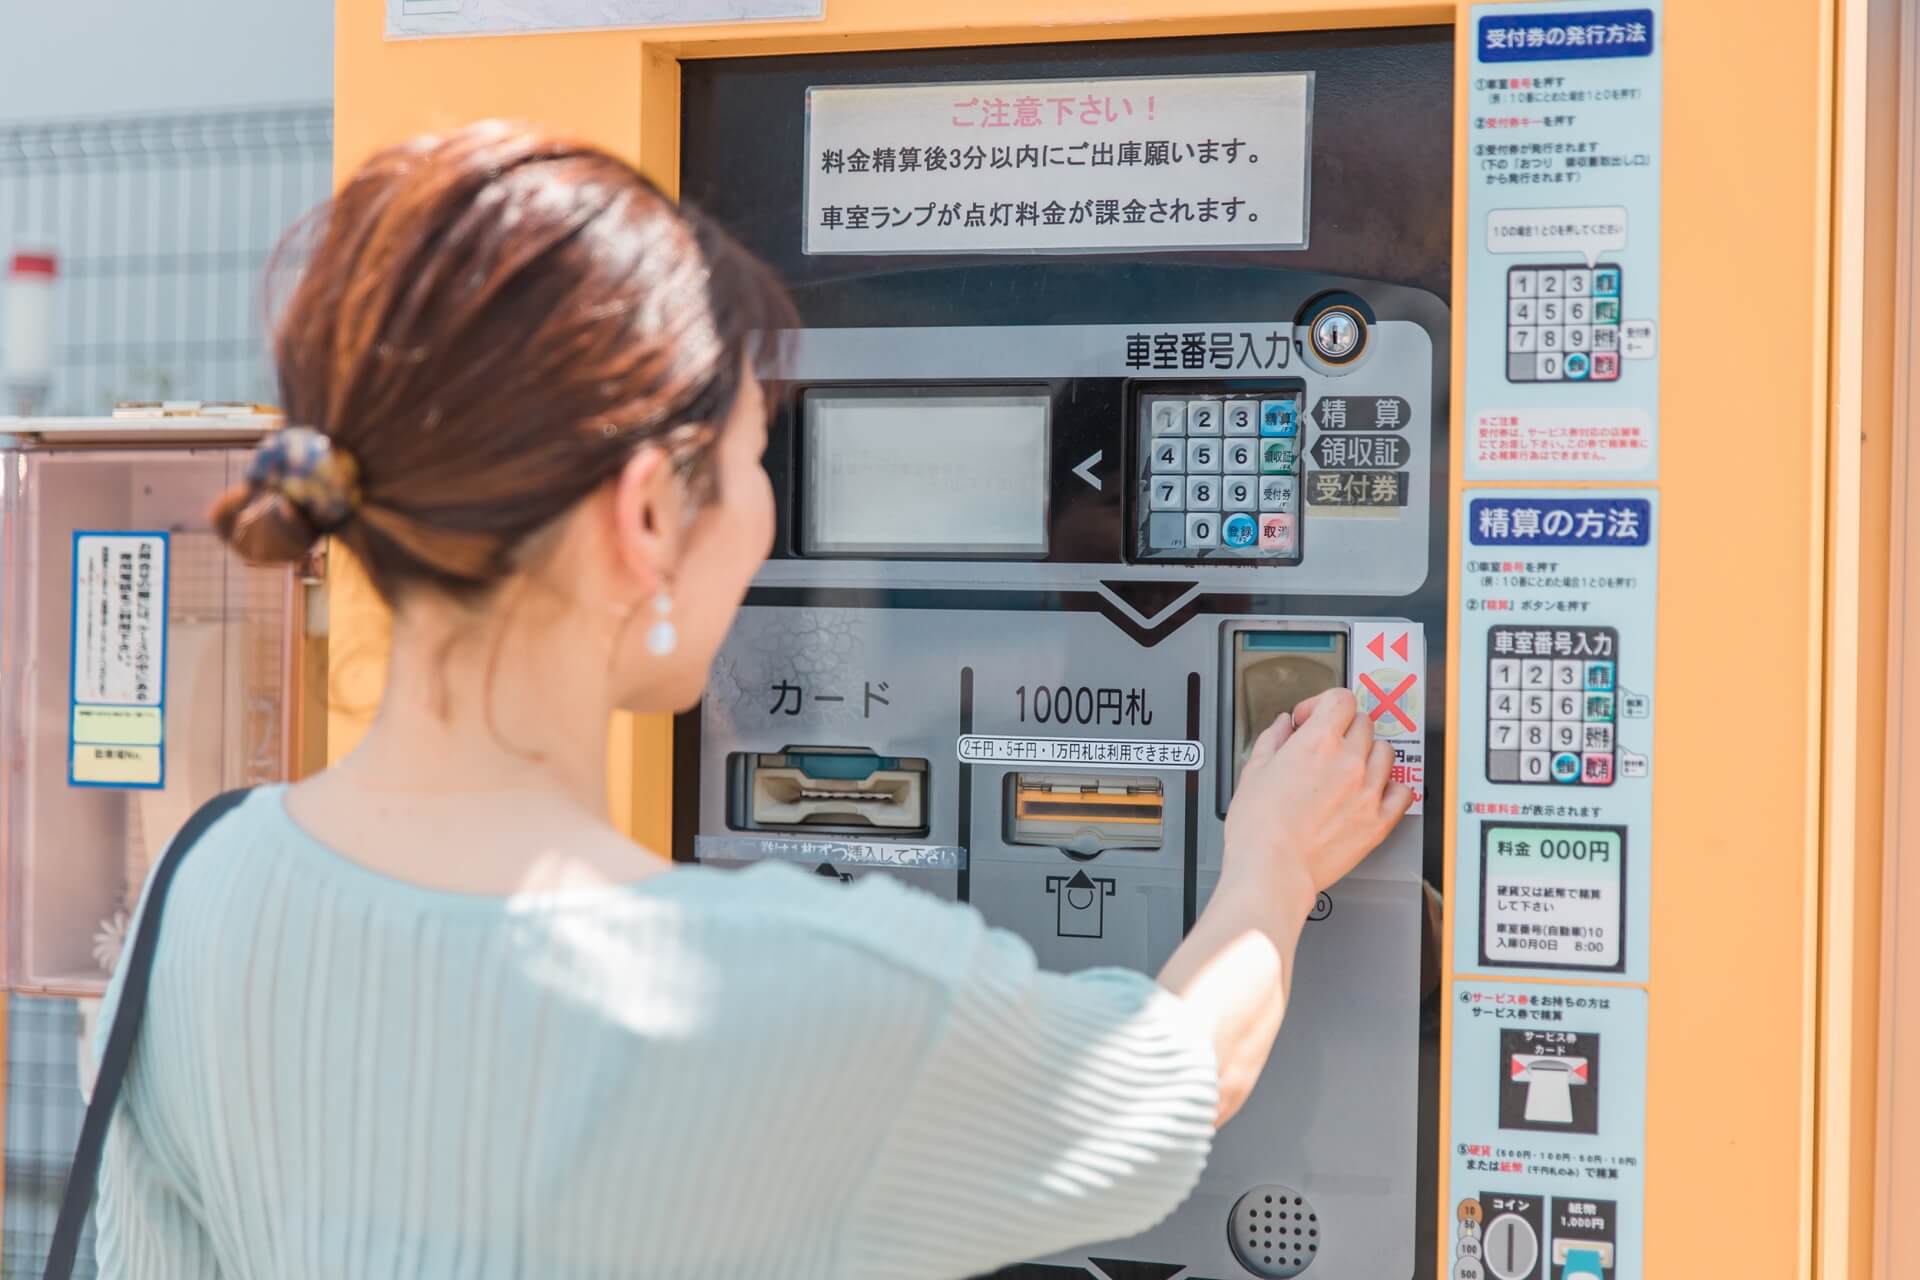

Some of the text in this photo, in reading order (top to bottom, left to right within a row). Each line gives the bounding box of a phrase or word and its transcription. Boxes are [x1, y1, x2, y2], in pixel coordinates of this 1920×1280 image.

[1485, 23, 1647, 49] 受付券の発行方法
[821, 137, 1260, 174] 料金精算後3分以内にご出庫願います。
[821, 196, 1260, 231] 車室ランプが点灯料金が課金されます。
[1519, 276, 1528, 292] 1
[1545, 276, 1556, 292] 2
[1572, 275, 1583, 292] 3
[1517, 304, 1528, 320] 4
[1545, 304, 1556, 320] 5
[1572, 303, 1583, 319] 6
[1517, 331, 1528, 347] 7
[1544, 331, 1555, 347] 8
[1572, 330, 1583, 347] 9
[1125, 331, 1290, 370] 車室番号入力
[1544, 359, 1555, 374] 0
[1199, 411, 1211, 428] 2
[1235, 411, 1248, 427] 3
[1161, 448, 1174, 464] 4
[1198, 448, 1210, 464] 5
[1235, 448, 1248, 464] 6
[1321, 438, 1399, 467] 領収証
[1161, 485, 1292, 502] 7 8 9 受付券
[1316, 473, 1398, 503] 受付券
[1197, 523, 1209, 539] 0
[1479, 508, 1639, 538] 精算の方法
[1495, 631, 1613, 656] 車室番号入力
[1500, 667, 1510, 683] 1
[1530, 667, 1543, 683] 2
[1561, 667, 1574, 684] 3
[769, 679, 890, 719] カード
[1016, 685, 1153, 726] 1000円札
[1499, 697, 1511, 713] 4
[1530, 697, 1542, 714] 5
[1561, 697, 1573, 715] 6
[1499, 727, 1511, 743] 7
[1530, 727, 1541, 744] 8
[1561, 728, 1573, 745] 9
[963, 739, 1197, 763] 2千円・5千円・1万円札は利用できません
[1530, 758, 1541, 775] 0
[1497, 839, 1610, 862] 料金 000円
[1498, 900, 1555, 912] して下さい
[1535, 1045, 1566, 1056] カード
[1465, 1206, 1476, 1215] 10
[1493, 1198, 1530, 1211] コイン
[1461, 1245, 1477, 1254] 100
